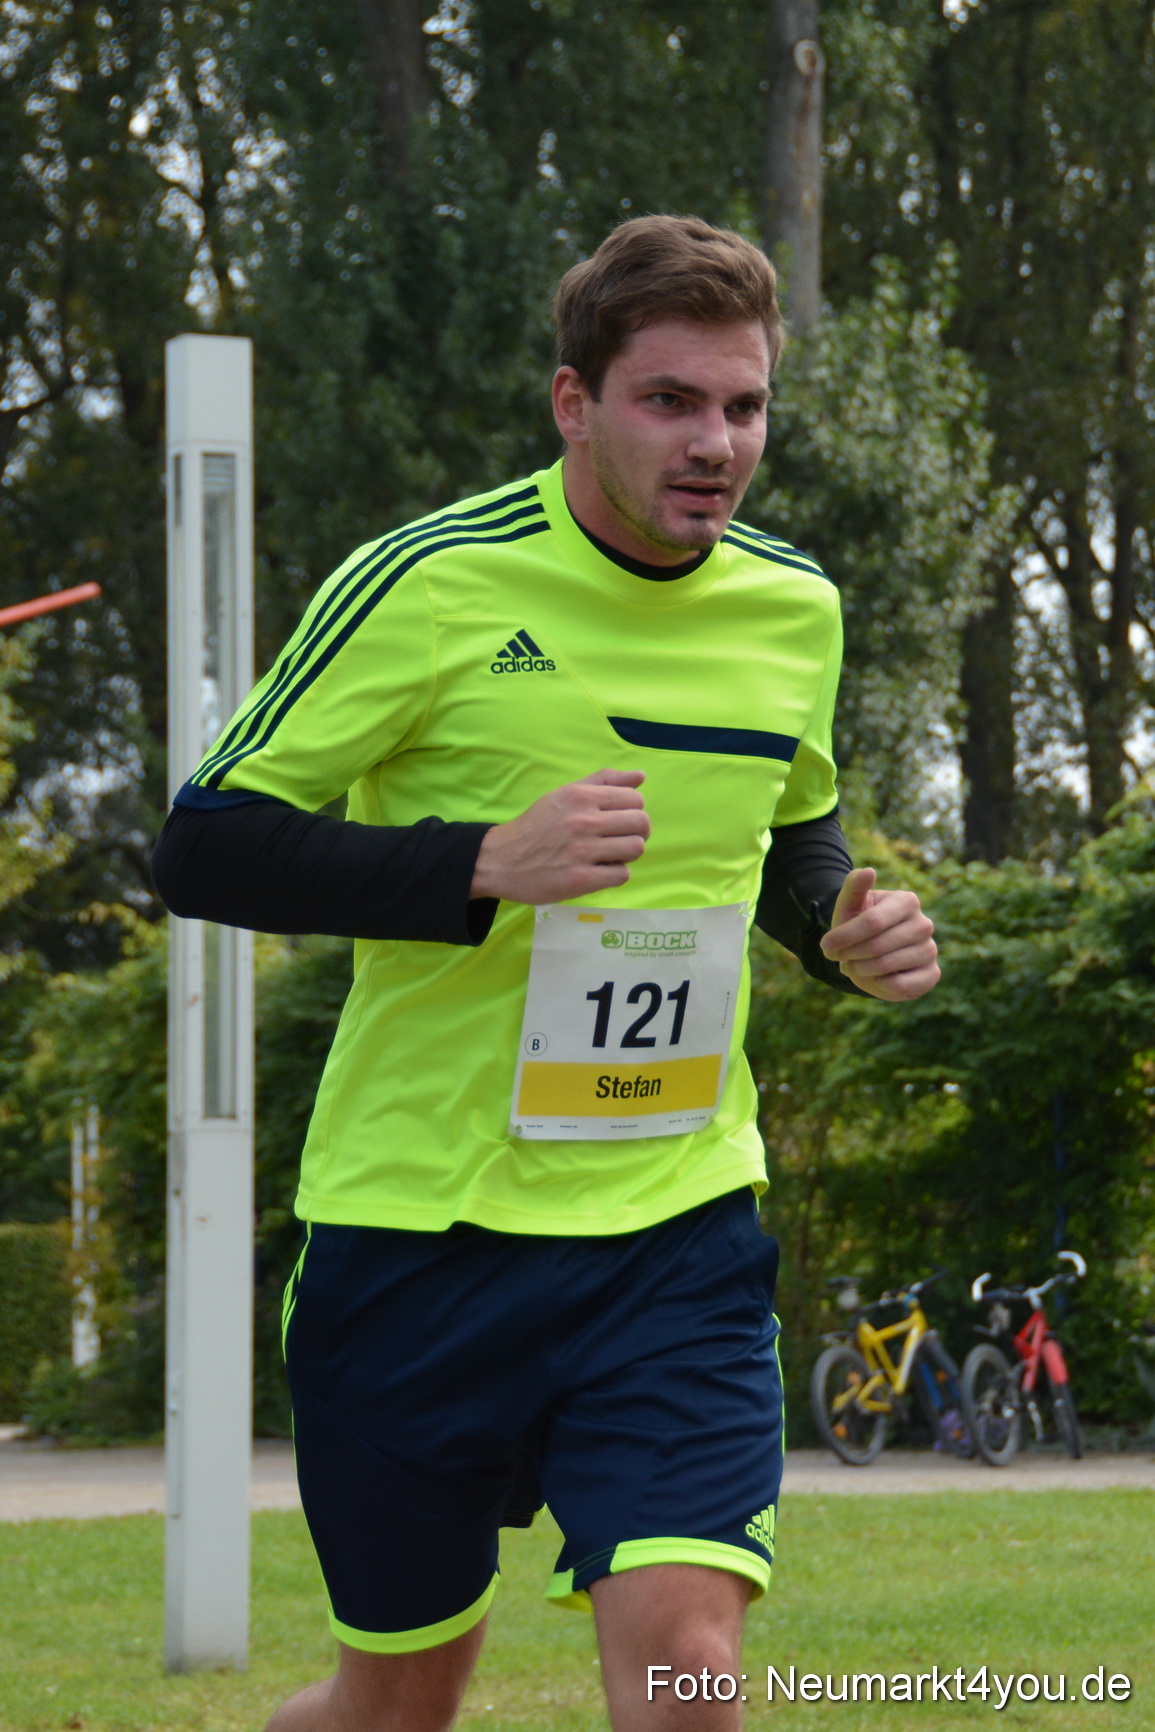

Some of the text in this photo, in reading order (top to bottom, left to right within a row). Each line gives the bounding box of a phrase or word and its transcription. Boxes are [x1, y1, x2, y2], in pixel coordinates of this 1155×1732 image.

[490, 656, 556, 674] adidas
[625, 930, 698, 950] BOCK
[586, 980, 690, 1048] 121
[532, 1039, 540, 1050] B
[595, 1075, 662, 1099] Stefan
[745, 1523, 774, 1557] adida
